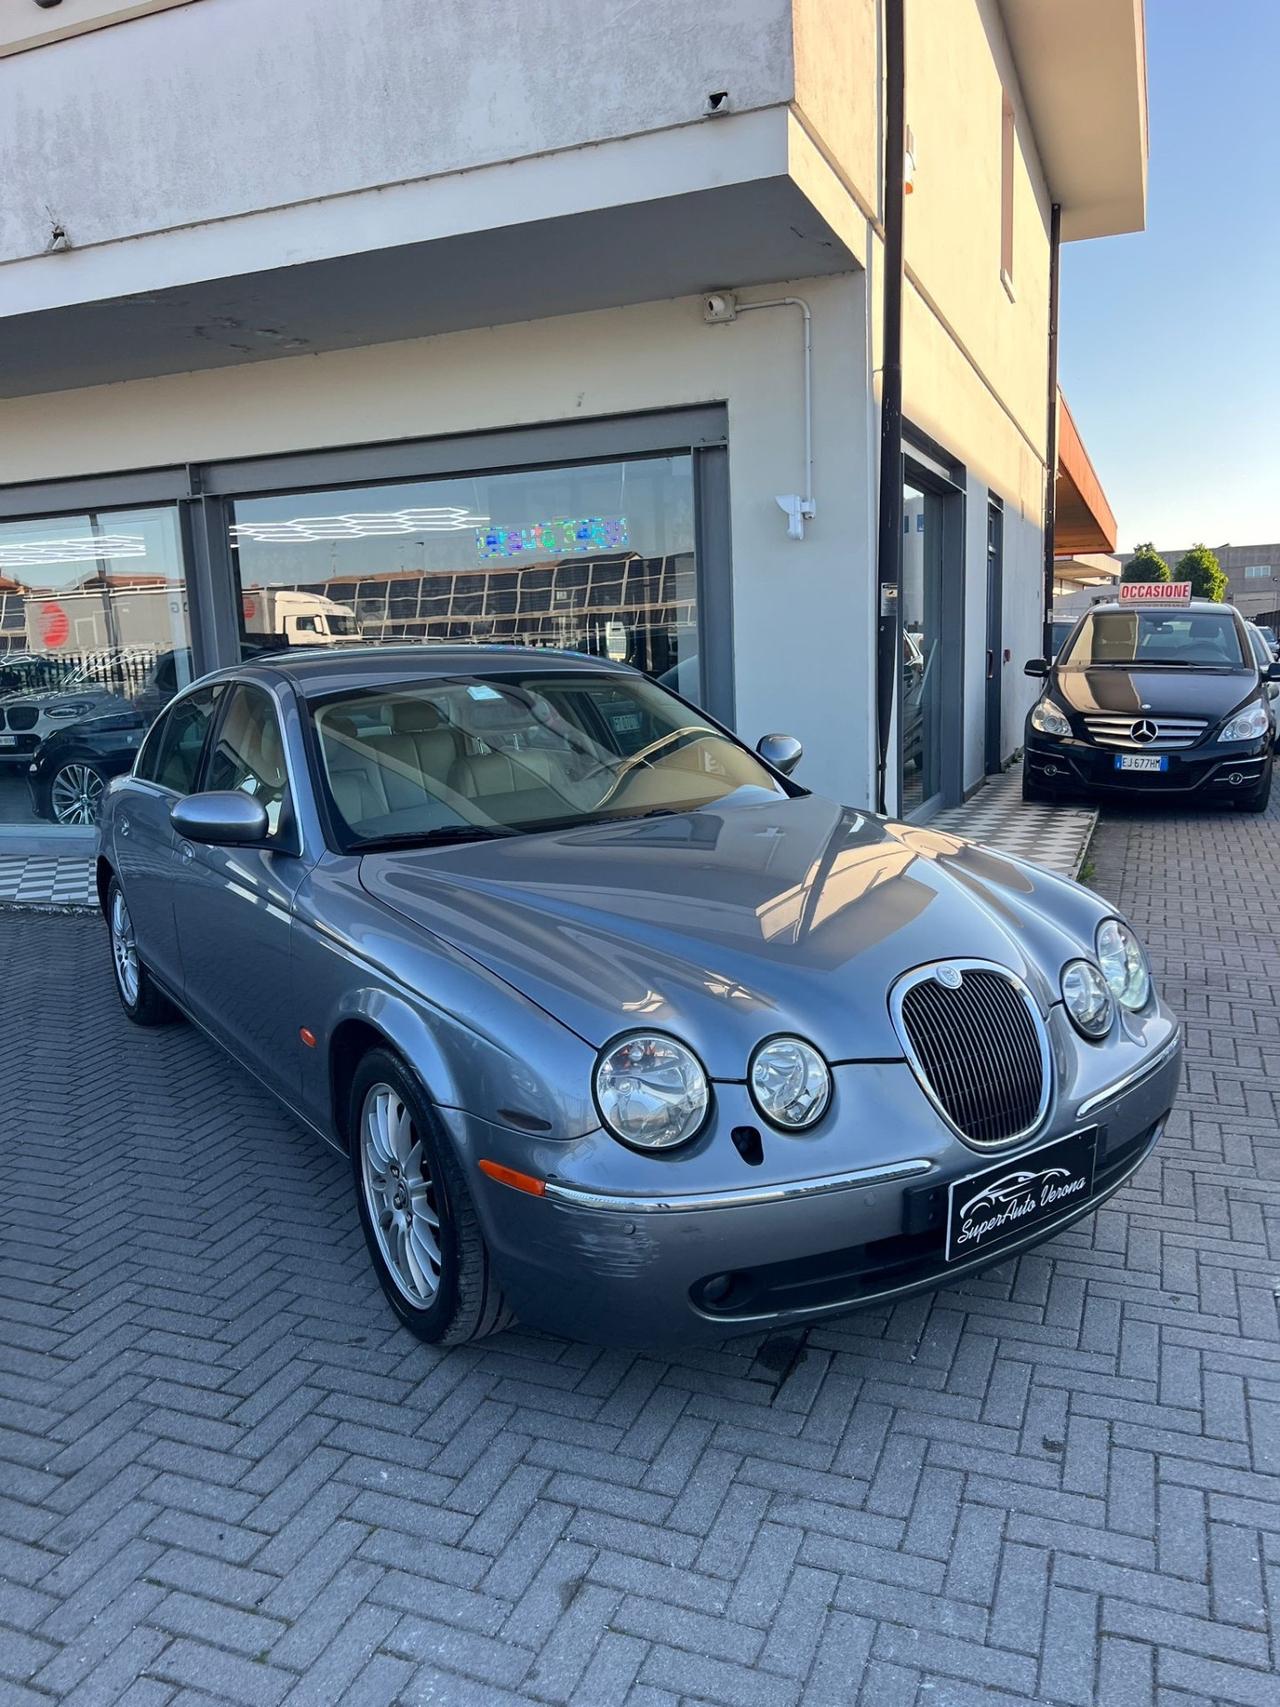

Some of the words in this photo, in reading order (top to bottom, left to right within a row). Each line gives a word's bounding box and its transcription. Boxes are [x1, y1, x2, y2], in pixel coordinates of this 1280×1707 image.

[1121, 585, 1189, 598] OCCASIONE
[957, 1194, 1037, 1243] SuperAuto
[1040, 1177, 1086, 1206] Verona
